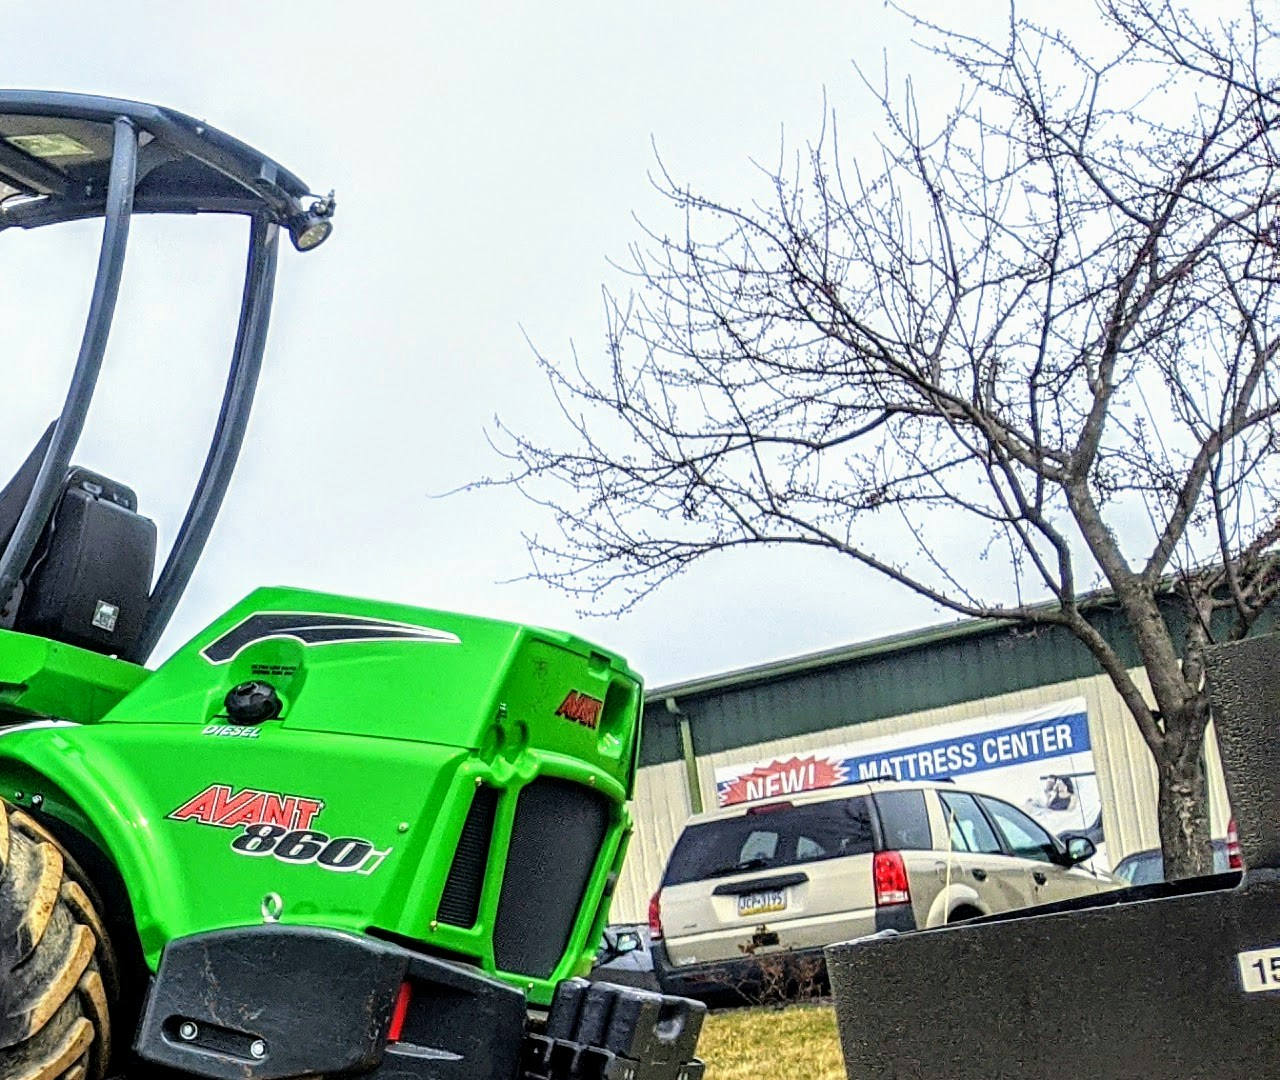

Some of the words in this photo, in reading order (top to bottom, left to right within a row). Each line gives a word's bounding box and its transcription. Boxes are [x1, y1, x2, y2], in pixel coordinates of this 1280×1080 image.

[202, 724, 262, 739] DIESEL
[746, 763, 815, 800] NEW!
[858, 745, 977, 781] MATTRESS
[982, 725, 1073, 764] CENTER
[166, 784, 321, 830] AVANT
